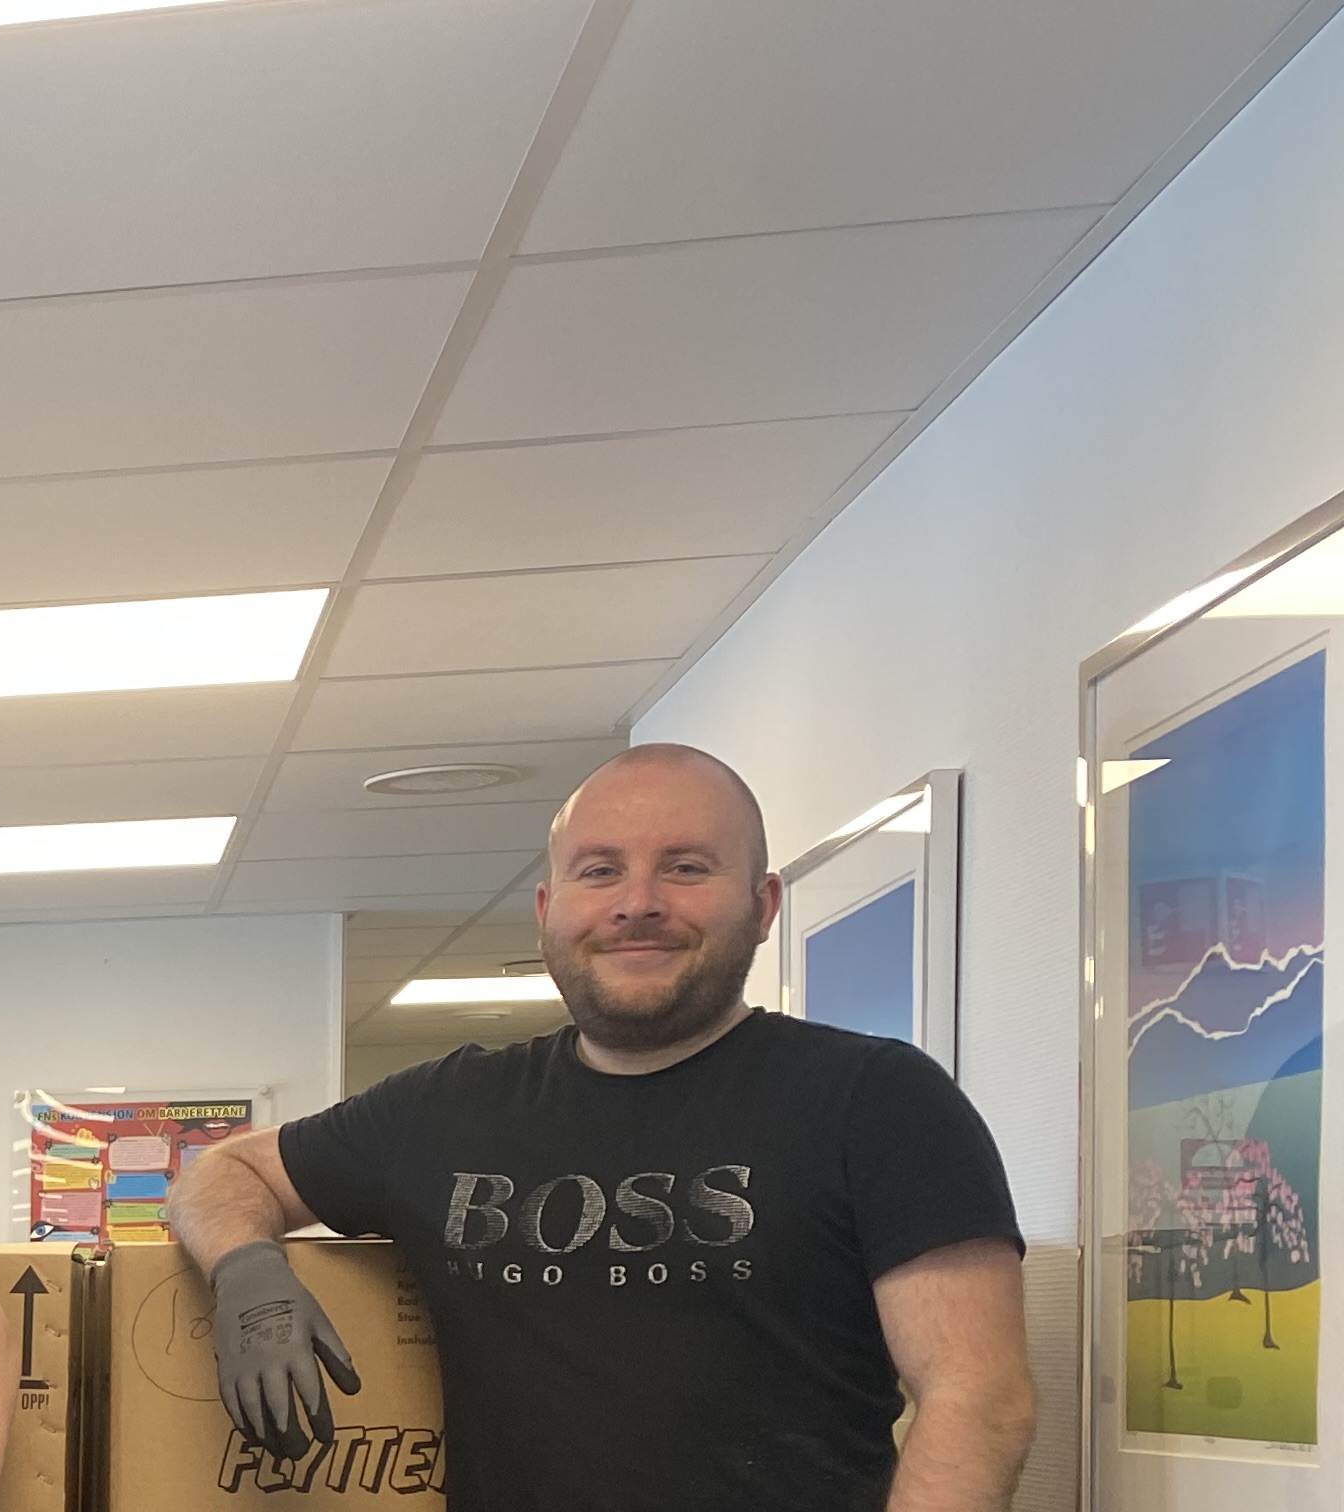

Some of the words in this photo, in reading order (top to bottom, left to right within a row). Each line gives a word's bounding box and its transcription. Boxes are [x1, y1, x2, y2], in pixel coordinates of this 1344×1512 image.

[137, 1108, 156, 1119] OM
[444, 1164, 754, 1255] BOSS
[609, 1259, 752, 1286] BOSS
[21, 1393, 49, 1410] OPP!
[217, 1425, 447, 1494] FLYTTE
